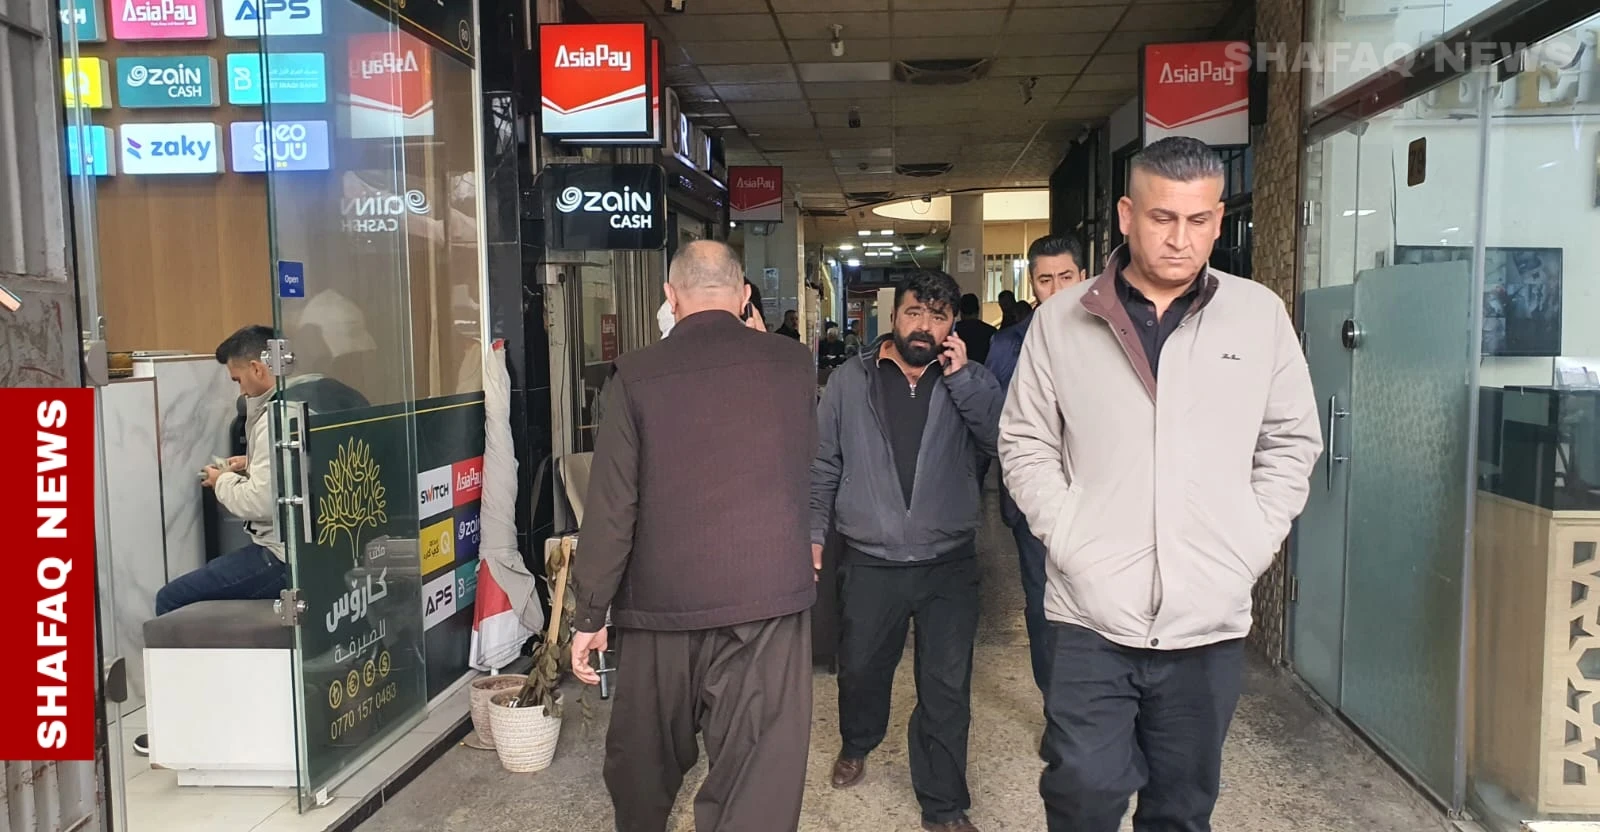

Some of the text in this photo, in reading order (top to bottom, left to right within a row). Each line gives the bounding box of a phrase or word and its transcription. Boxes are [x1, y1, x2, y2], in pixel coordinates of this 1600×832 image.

[122, 0, 197, 26] AsiaPay
[235, 0, 311, 21] APS
[555, 44, 631, 71] AsiaPay
[1159, 61, 1235, 85] AsiaPay
[168, 86, 203, 98] CASH
[151, 135, 211, 161] zaky
[736, 177, 775, 190] AsiaPay
[610, 214, 652, 228] CASH
[284, 274, 299, 285] Open
[421, 483, 449, 505] SWITCH
[425, 584, 452, 617] APS
[331, 682, 396, 740] 0770 157 0483
